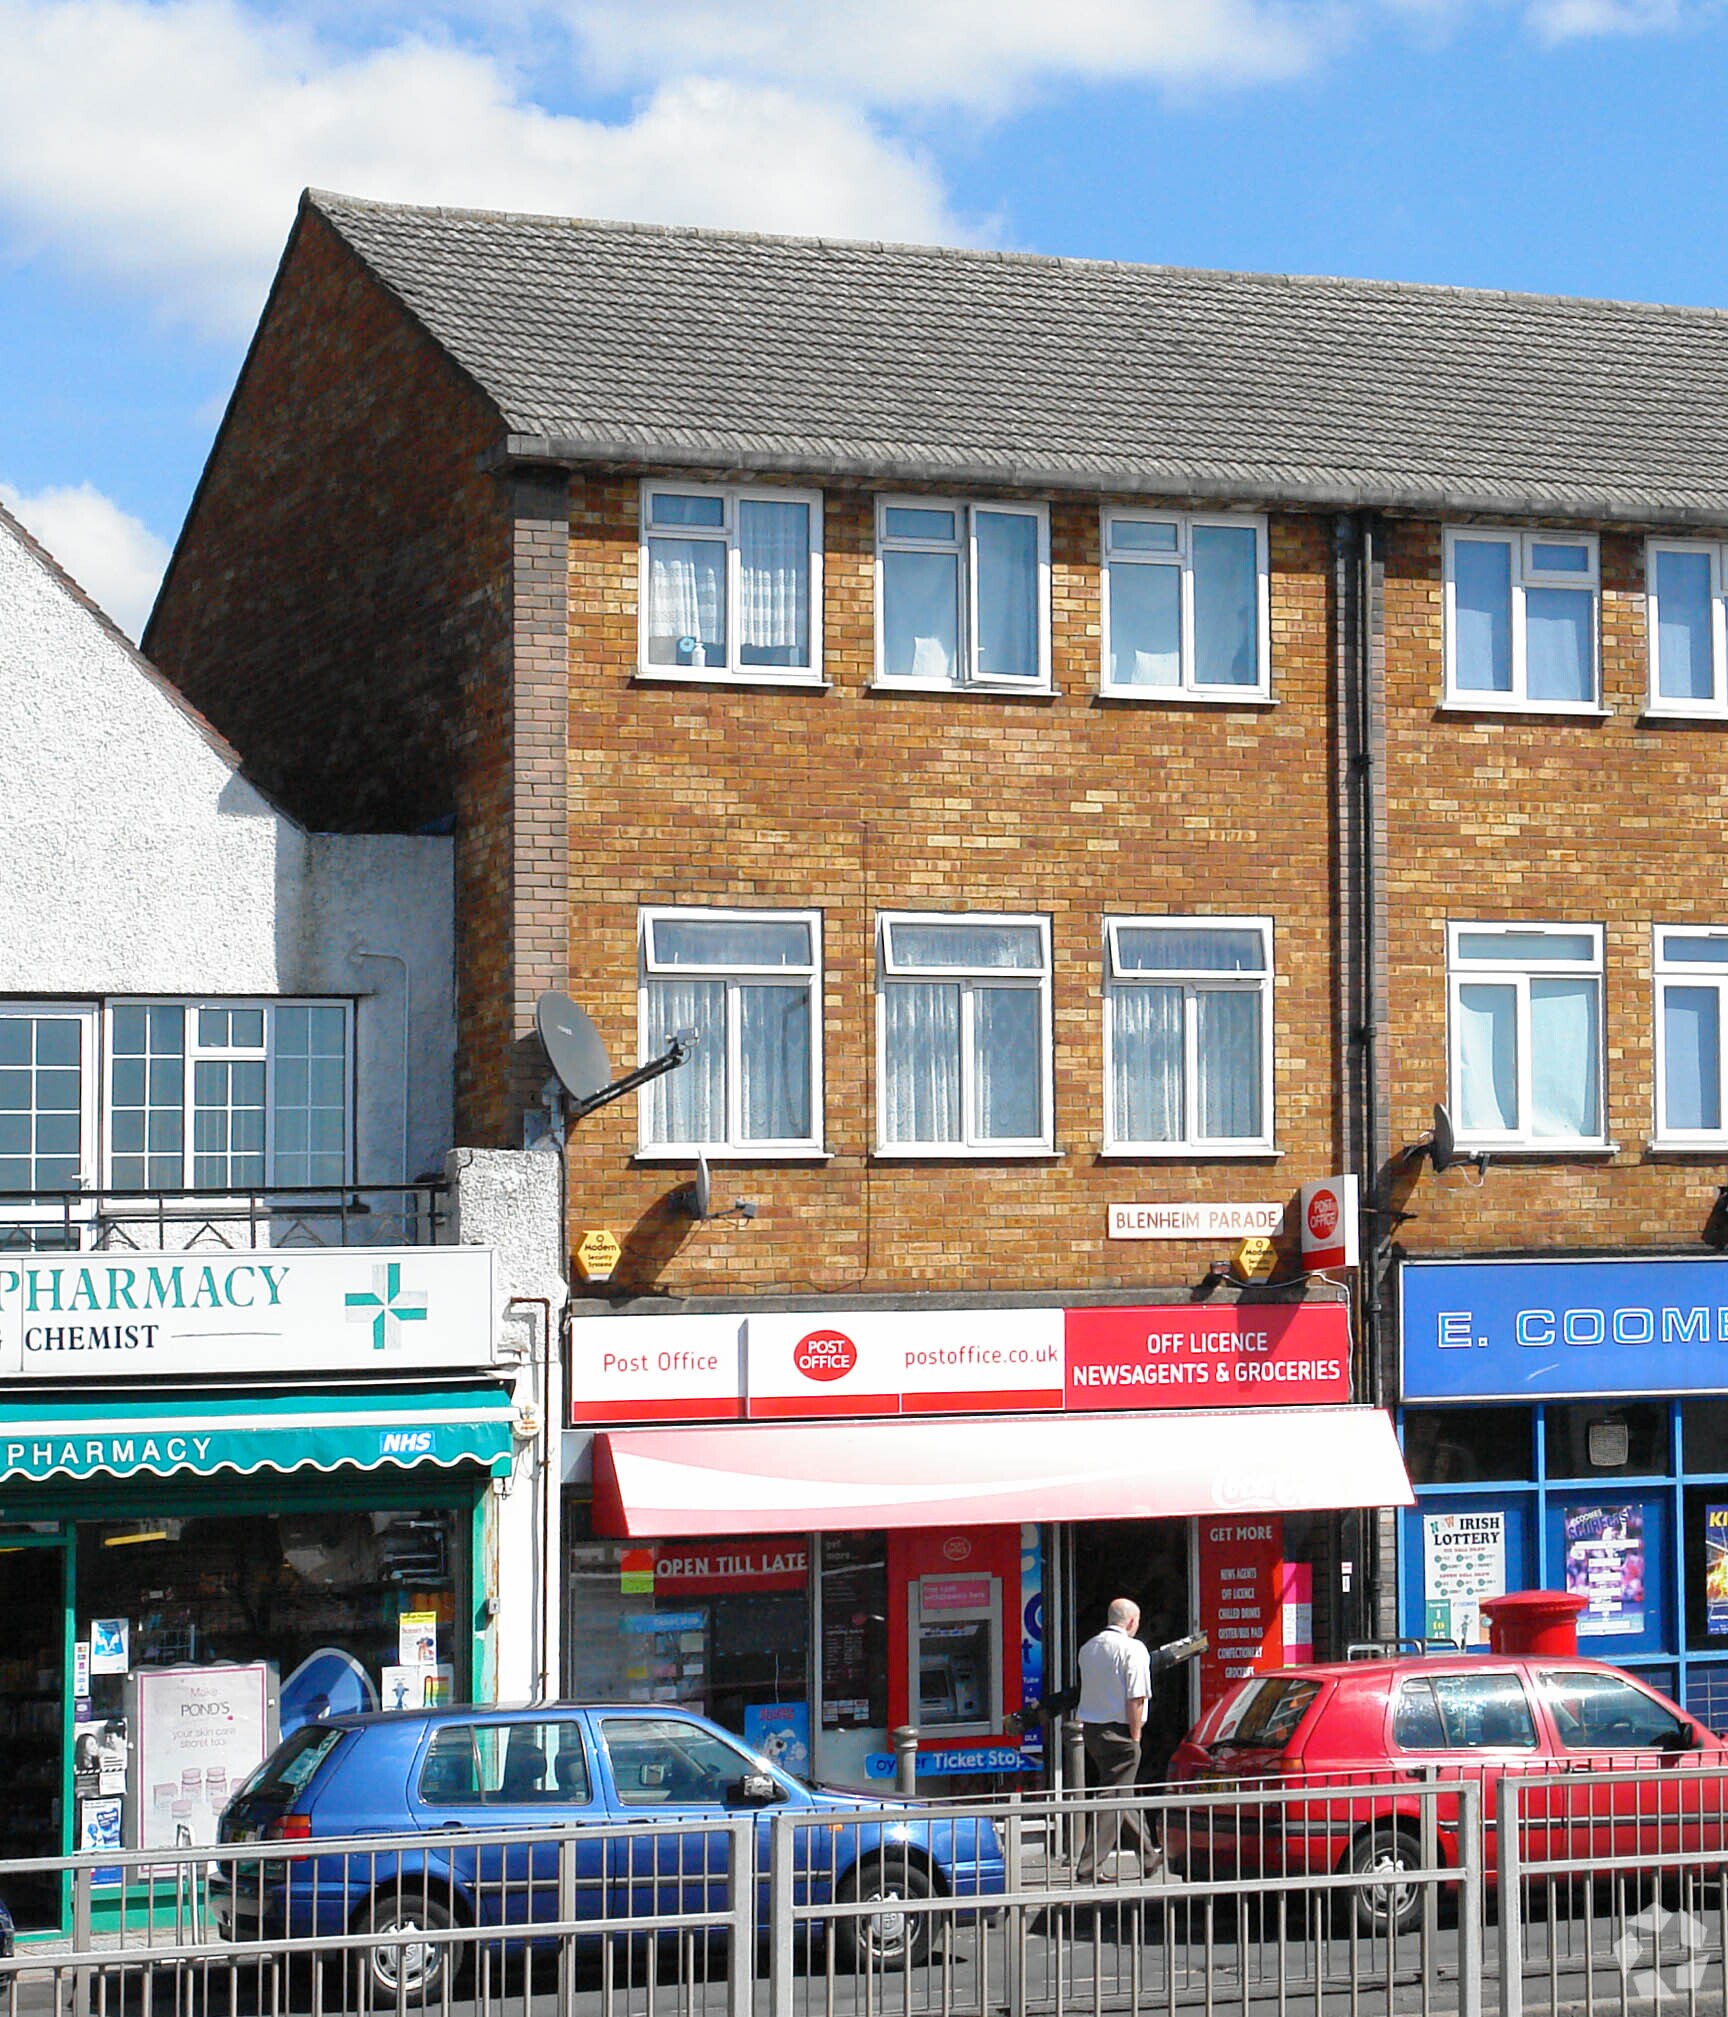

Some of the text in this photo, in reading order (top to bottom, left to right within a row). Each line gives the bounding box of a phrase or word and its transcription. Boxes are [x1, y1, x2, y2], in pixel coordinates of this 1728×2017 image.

[1313, 1198, 1334, 1214] POST
[1116, 1211, 1277, 1229] BLENHEIM PARADE
[1310, 1212, 1336, 1229] OFFICE
[584, 1242, 617, 1250] Modern
[25, 1325, 159, 1351] CHEMIST
[1438, 1312, 1489, 1348] E.
[808, 1340, 845, 1354] POST
[1147, 1332, 1268, 1353] OFF LICENCE
[603, 1351, 718, 1372] Post Office
[800, 1355, 850, 1370] OFFICE
[905, 1345, 1058, 1369] postoffice.co.uk
[1073, 1360, 1340, 1386] NEWSAGENTS & GROCERIES
[383, 1432, 433, 1453] NHS
[7, 1438, 211, 1466] PHARMACY
[1459, 1517, 1500, 1530] IRISH
[1210, 1526, 1273, 1542] GET MORE
[1433, 1532, 1500, 1546] LOTTERY
[657, 1553, 808, 1577] OPEN TILL LATE
[190, 1687, 218, 1697] Make
[181, 1702, 230, 1717] POND'S
[933, 1752, 984, 1769] Ticket
